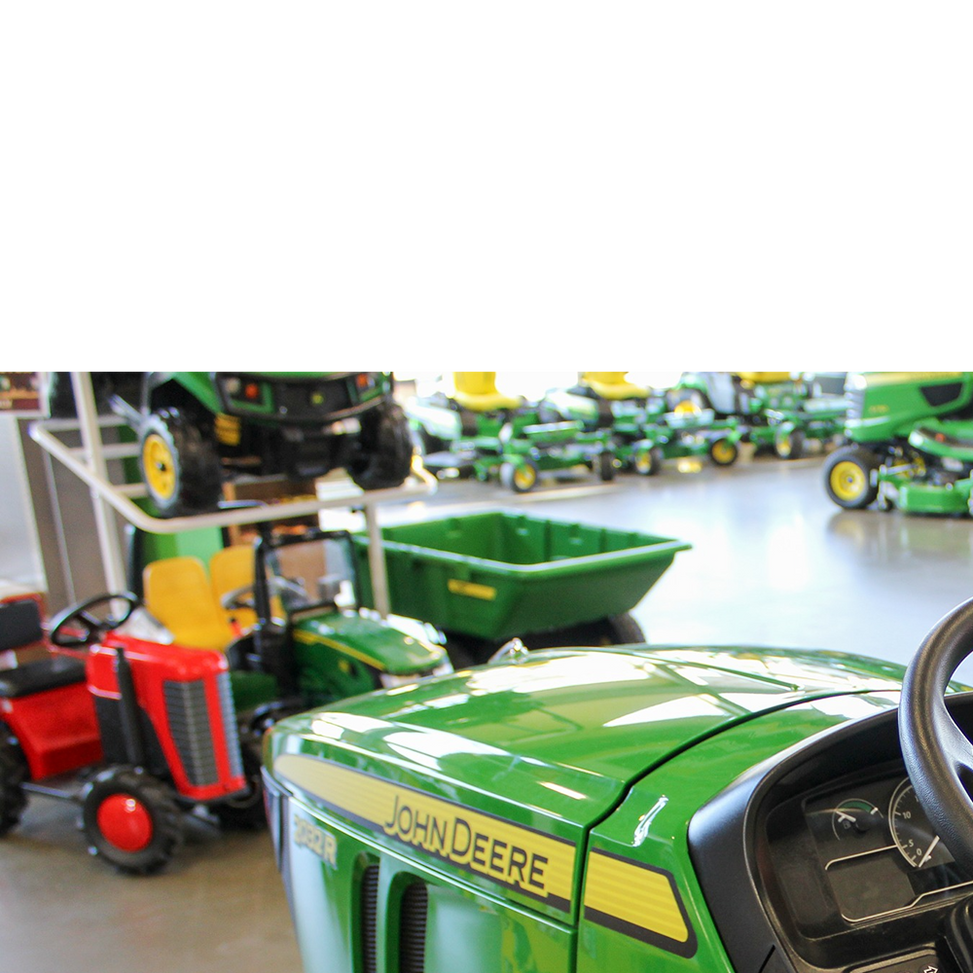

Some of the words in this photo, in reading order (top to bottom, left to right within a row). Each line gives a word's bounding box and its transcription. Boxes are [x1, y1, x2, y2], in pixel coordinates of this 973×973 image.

[902, 811, 911, 820] 10
[385, 796, 447, 850] JOHN
[453, 817, 548, 889] DEERE
[909, 839, 914, 847] 5
